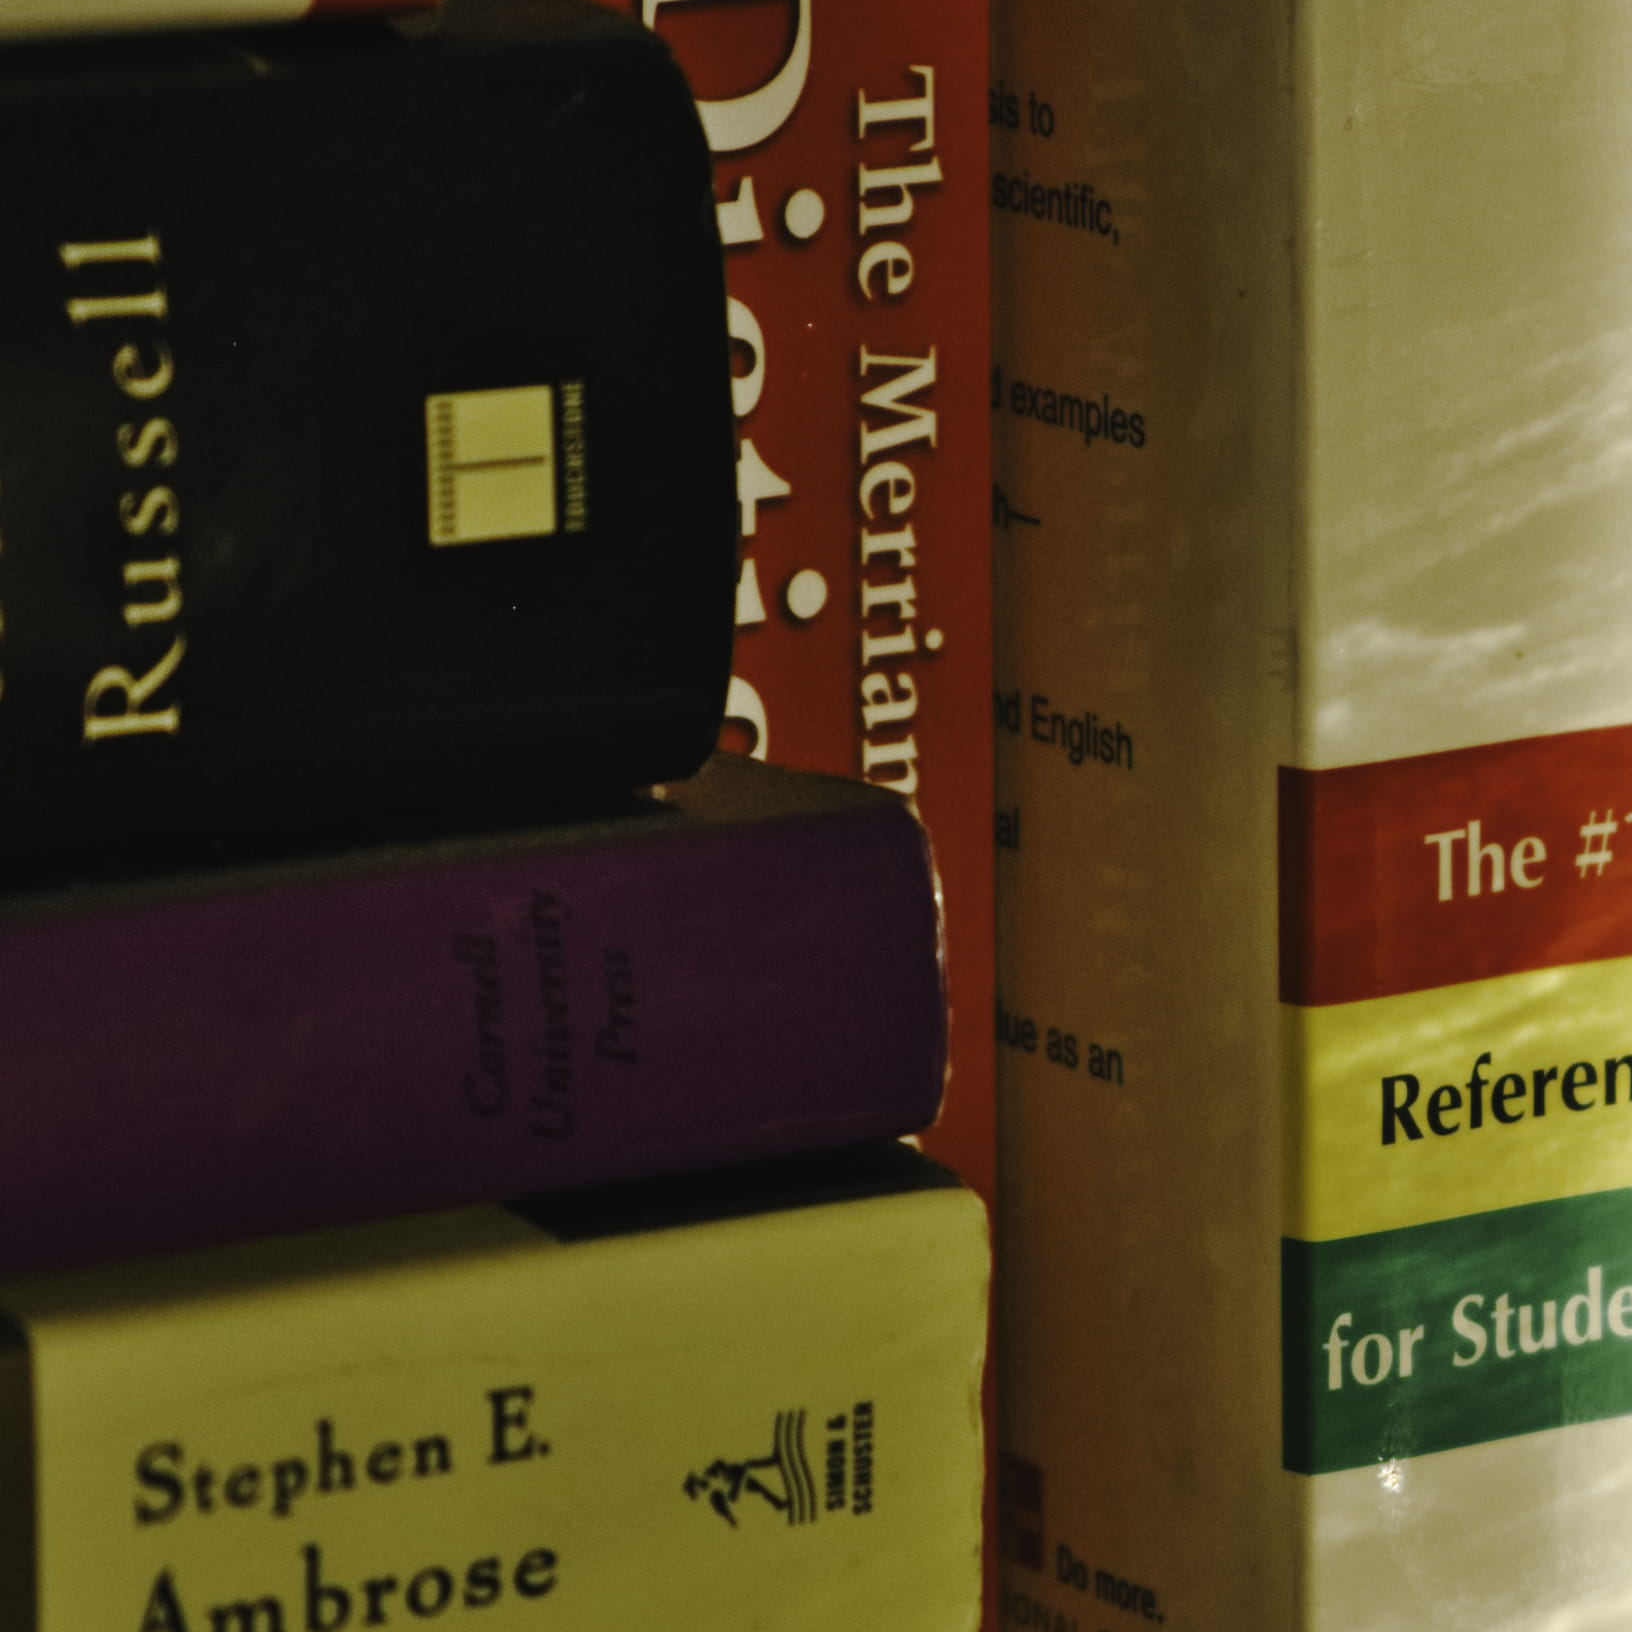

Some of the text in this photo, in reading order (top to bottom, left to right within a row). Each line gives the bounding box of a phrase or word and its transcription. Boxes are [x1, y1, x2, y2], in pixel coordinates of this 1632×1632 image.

[1029, 91, 1055, 139] to
[857, 63, 943, 302] The
[992, 172, 1119, 245] scientific,
[1010, 377, 1146, 448] examples
[57, 225, 188, 746] Russell
[561, 376, 588, 534] TOUCHSTONE
[1031, 693, 1133, 770] English
[1424, 820, 1547, 902] The
[1046, 1026, 1079, 1069] as
[1088, 1042, 1123, 1086] an
[1322, 1311, 1425, 1391] for
[132, 1385, 553, 1528] Stephen E.
[826, 1414, 846, 1510] SIMON &
[853, 1401, 873, 1515] SCHUSTER
[1057, 1542, 1166, 1624] Do more.
